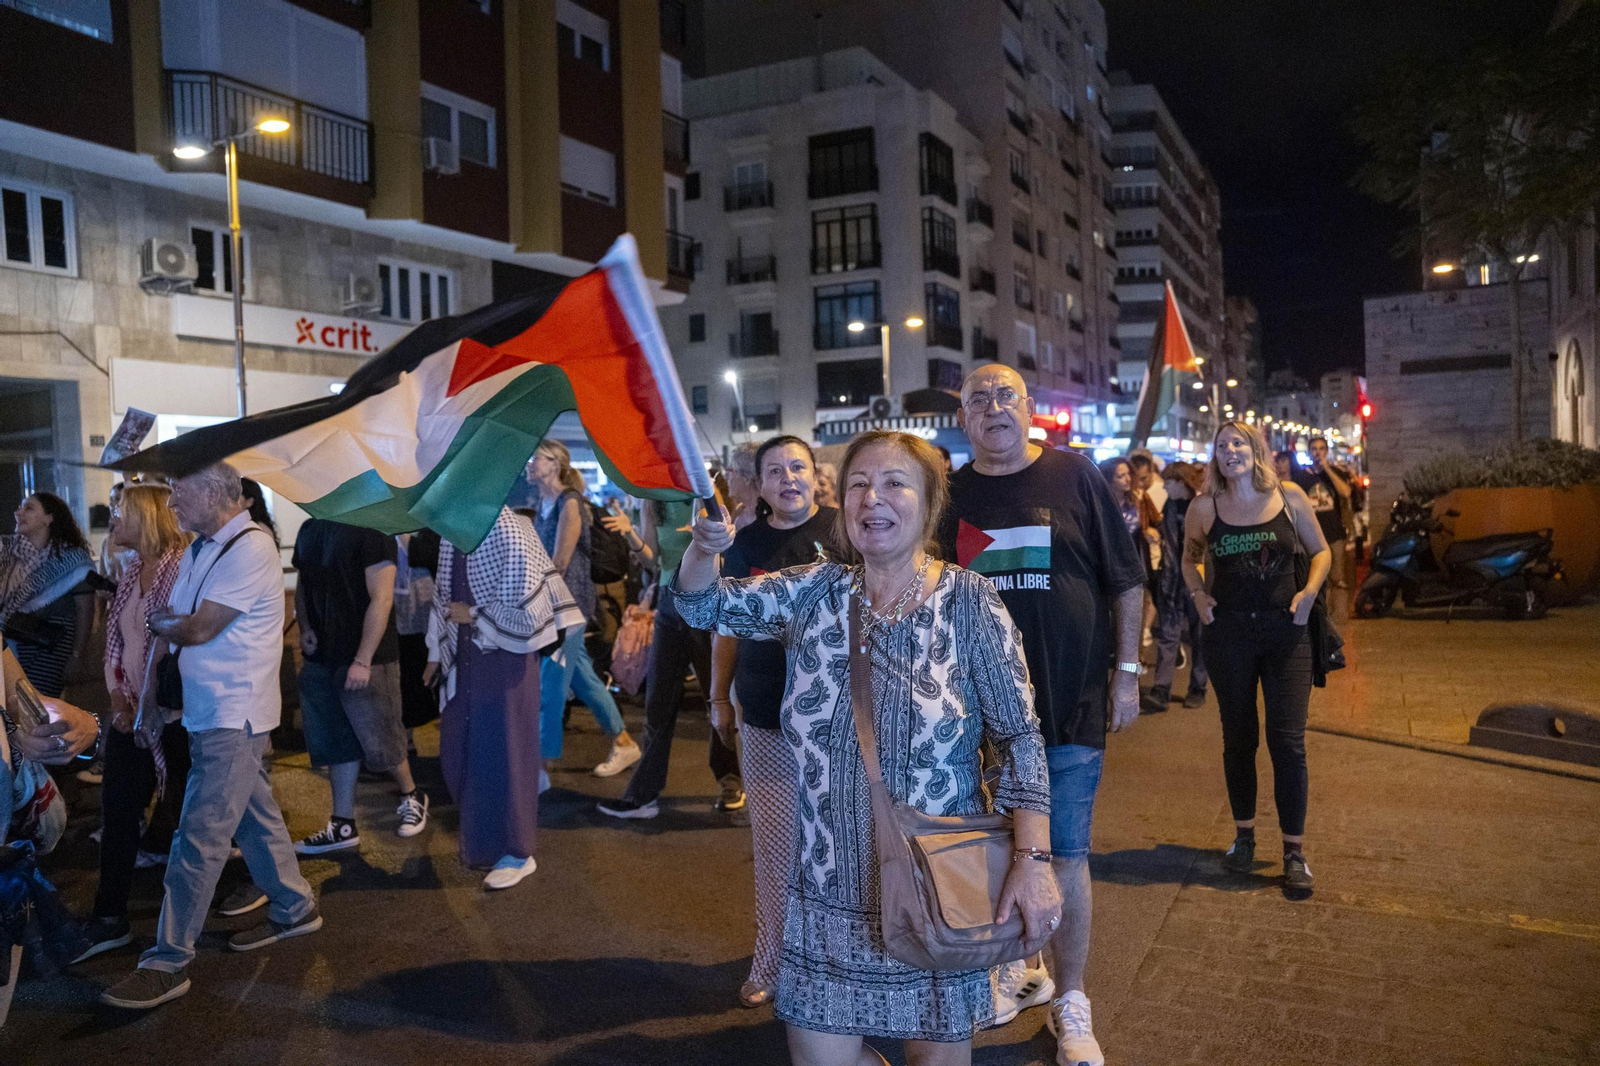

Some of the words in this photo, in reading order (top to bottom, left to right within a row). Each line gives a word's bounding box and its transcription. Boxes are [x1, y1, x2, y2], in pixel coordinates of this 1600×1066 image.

[1220, 531, 1278, 546] GRANADA
[1214, 541, 1261, 557] CUIDADO
[1016, 573, 1051, 590] LIBRE
